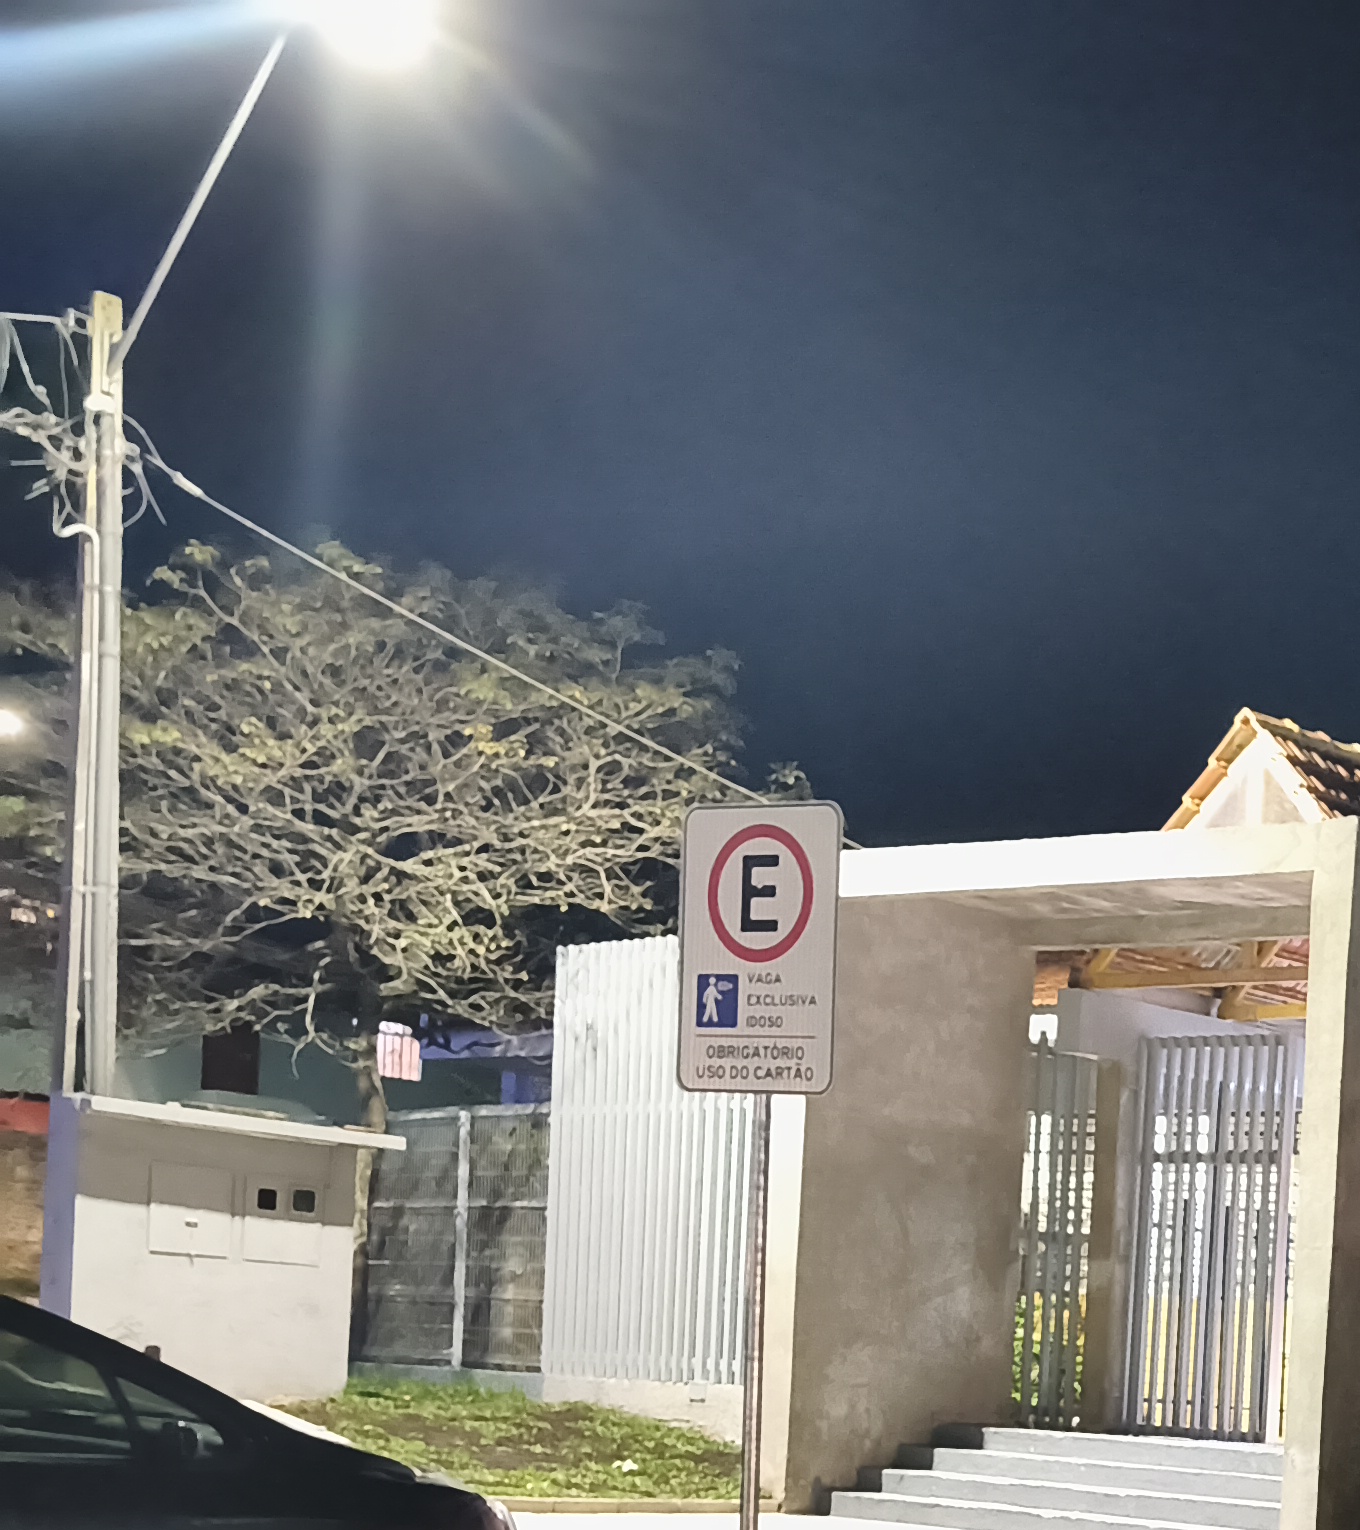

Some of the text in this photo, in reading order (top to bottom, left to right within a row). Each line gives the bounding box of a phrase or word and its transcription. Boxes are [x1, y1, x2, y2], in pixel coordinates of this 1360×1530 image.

[741, 855, 779, 932] E
[747, 972, 782, 985] VAGA
[746, 993, 818, 1007] EXCLUSIVA
[746, 1015, 784, 1029] IDOSO
[705, 1040, 805, 1061] OBRIGATÓRIO
[696, 1062, 814, 1082] USO DO CARTÃO
